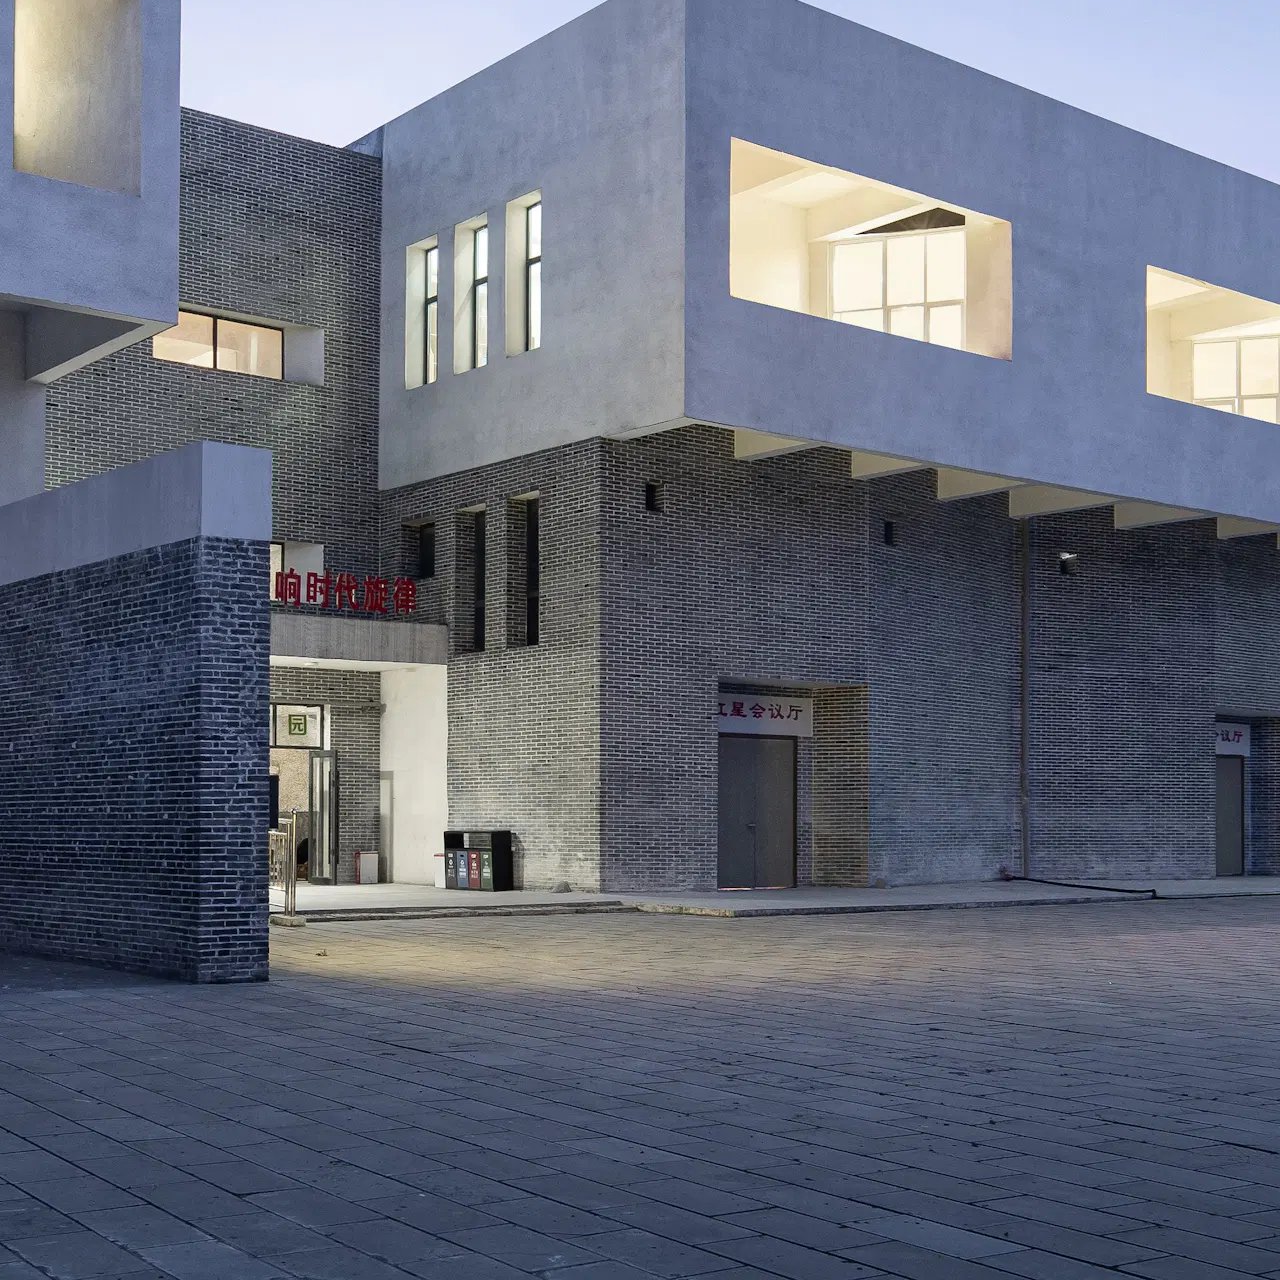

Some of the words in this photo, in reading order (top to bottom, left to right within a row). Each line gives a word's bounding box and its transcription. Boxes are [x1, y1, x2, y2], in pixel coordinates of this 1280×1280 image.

[276, 568, 417, 614] 响时代旋律
[1216, 729, 1243, 743] 议厅
